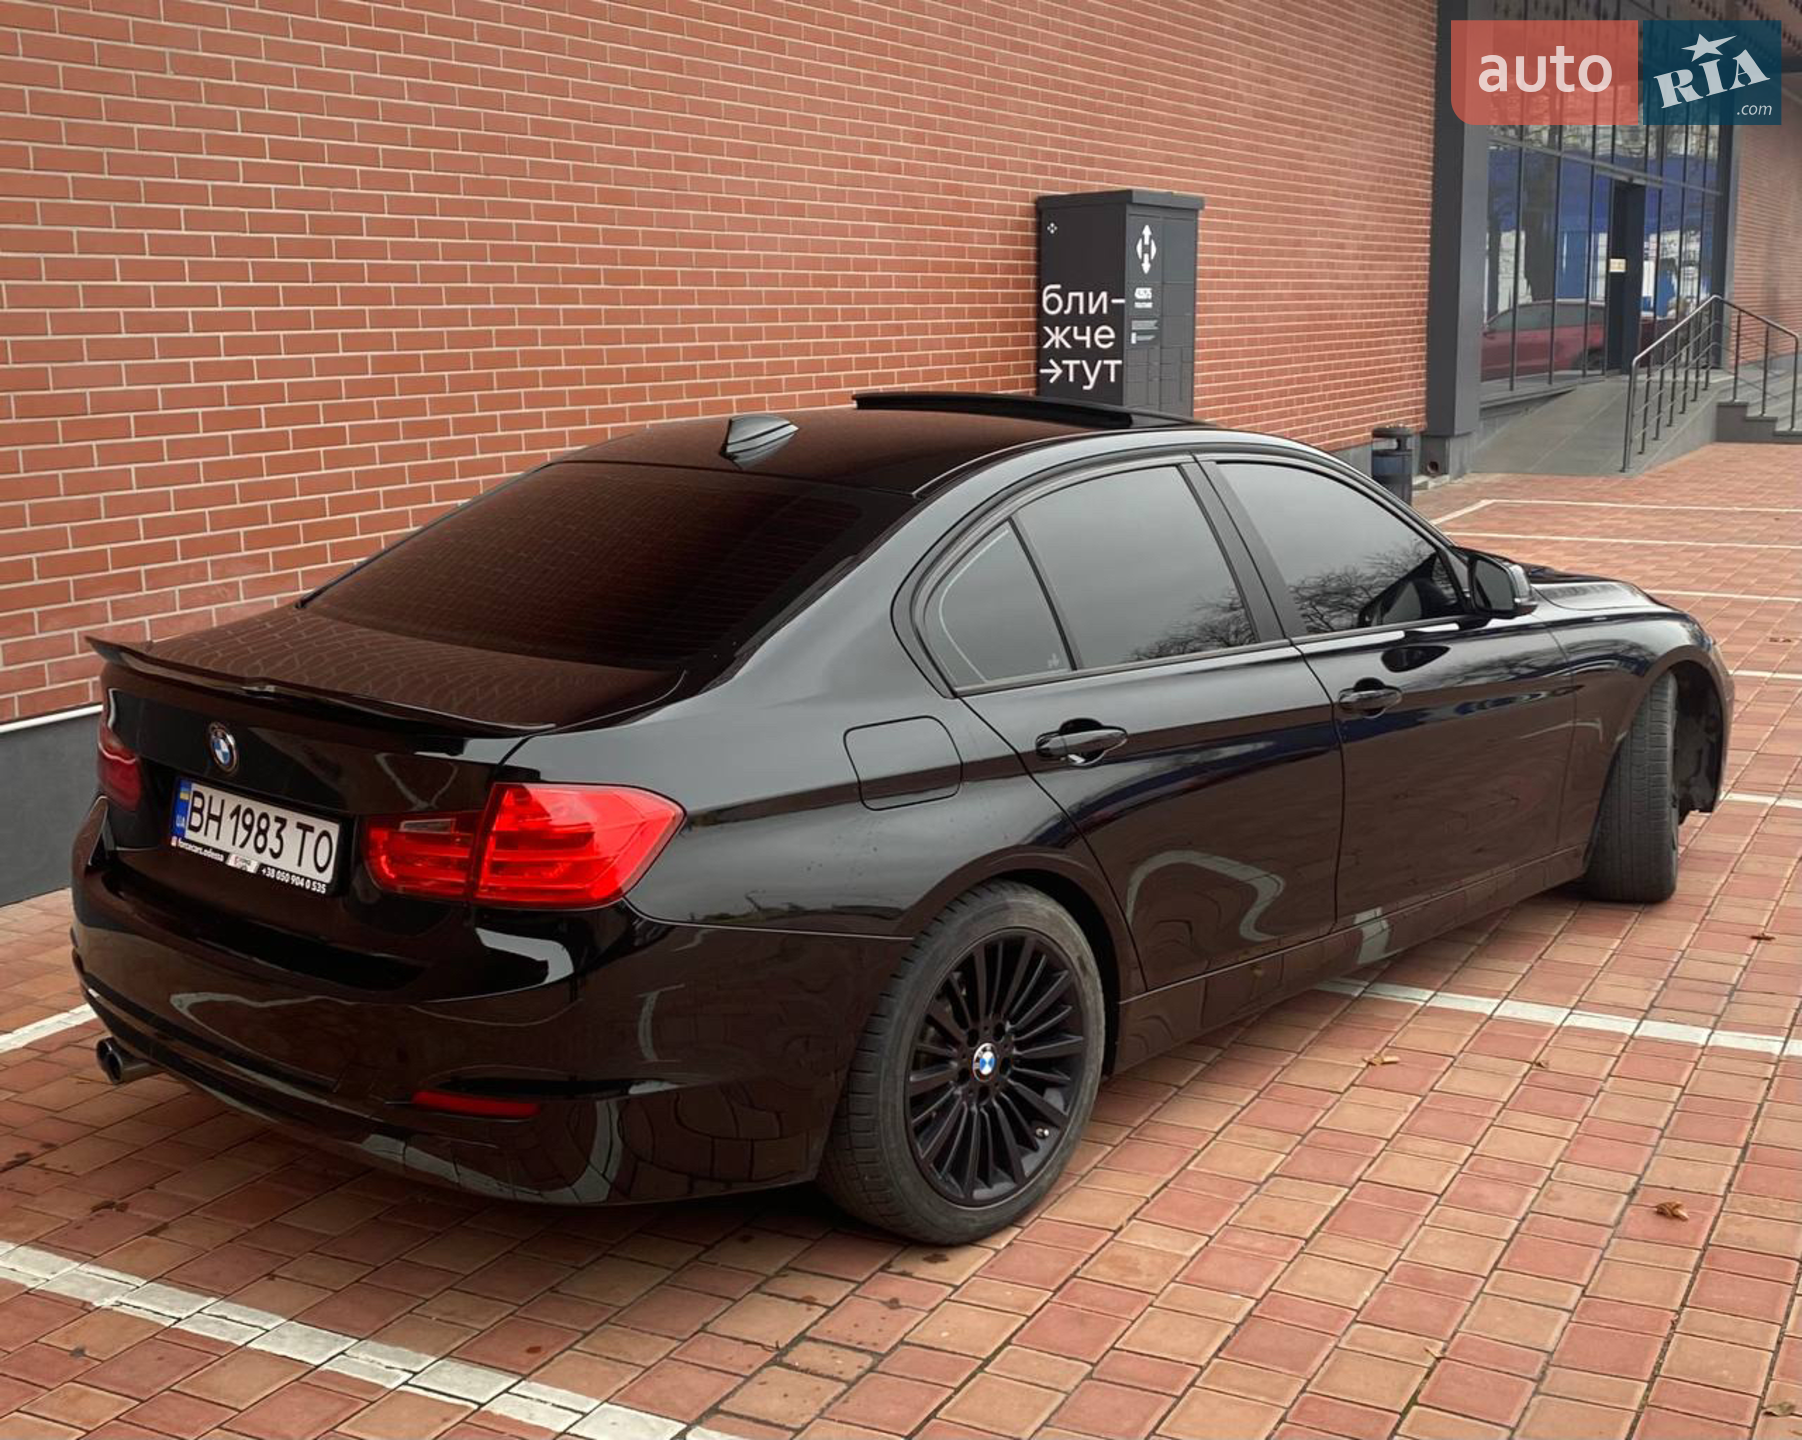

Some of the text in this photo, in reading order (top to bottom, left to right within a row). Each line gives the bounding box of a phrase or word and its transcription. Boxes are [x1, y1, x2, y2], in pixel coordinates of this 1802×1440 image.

[1042, 284, 1125, 315] бли-
[1042, 325, 1116, 349] жче
[1062, 360, 1122, 390] тут
[188, 790, 333, 873] BH 1983 TO
[290, 874, 305, 888] 904
[311, 880, 326, 894] 535
